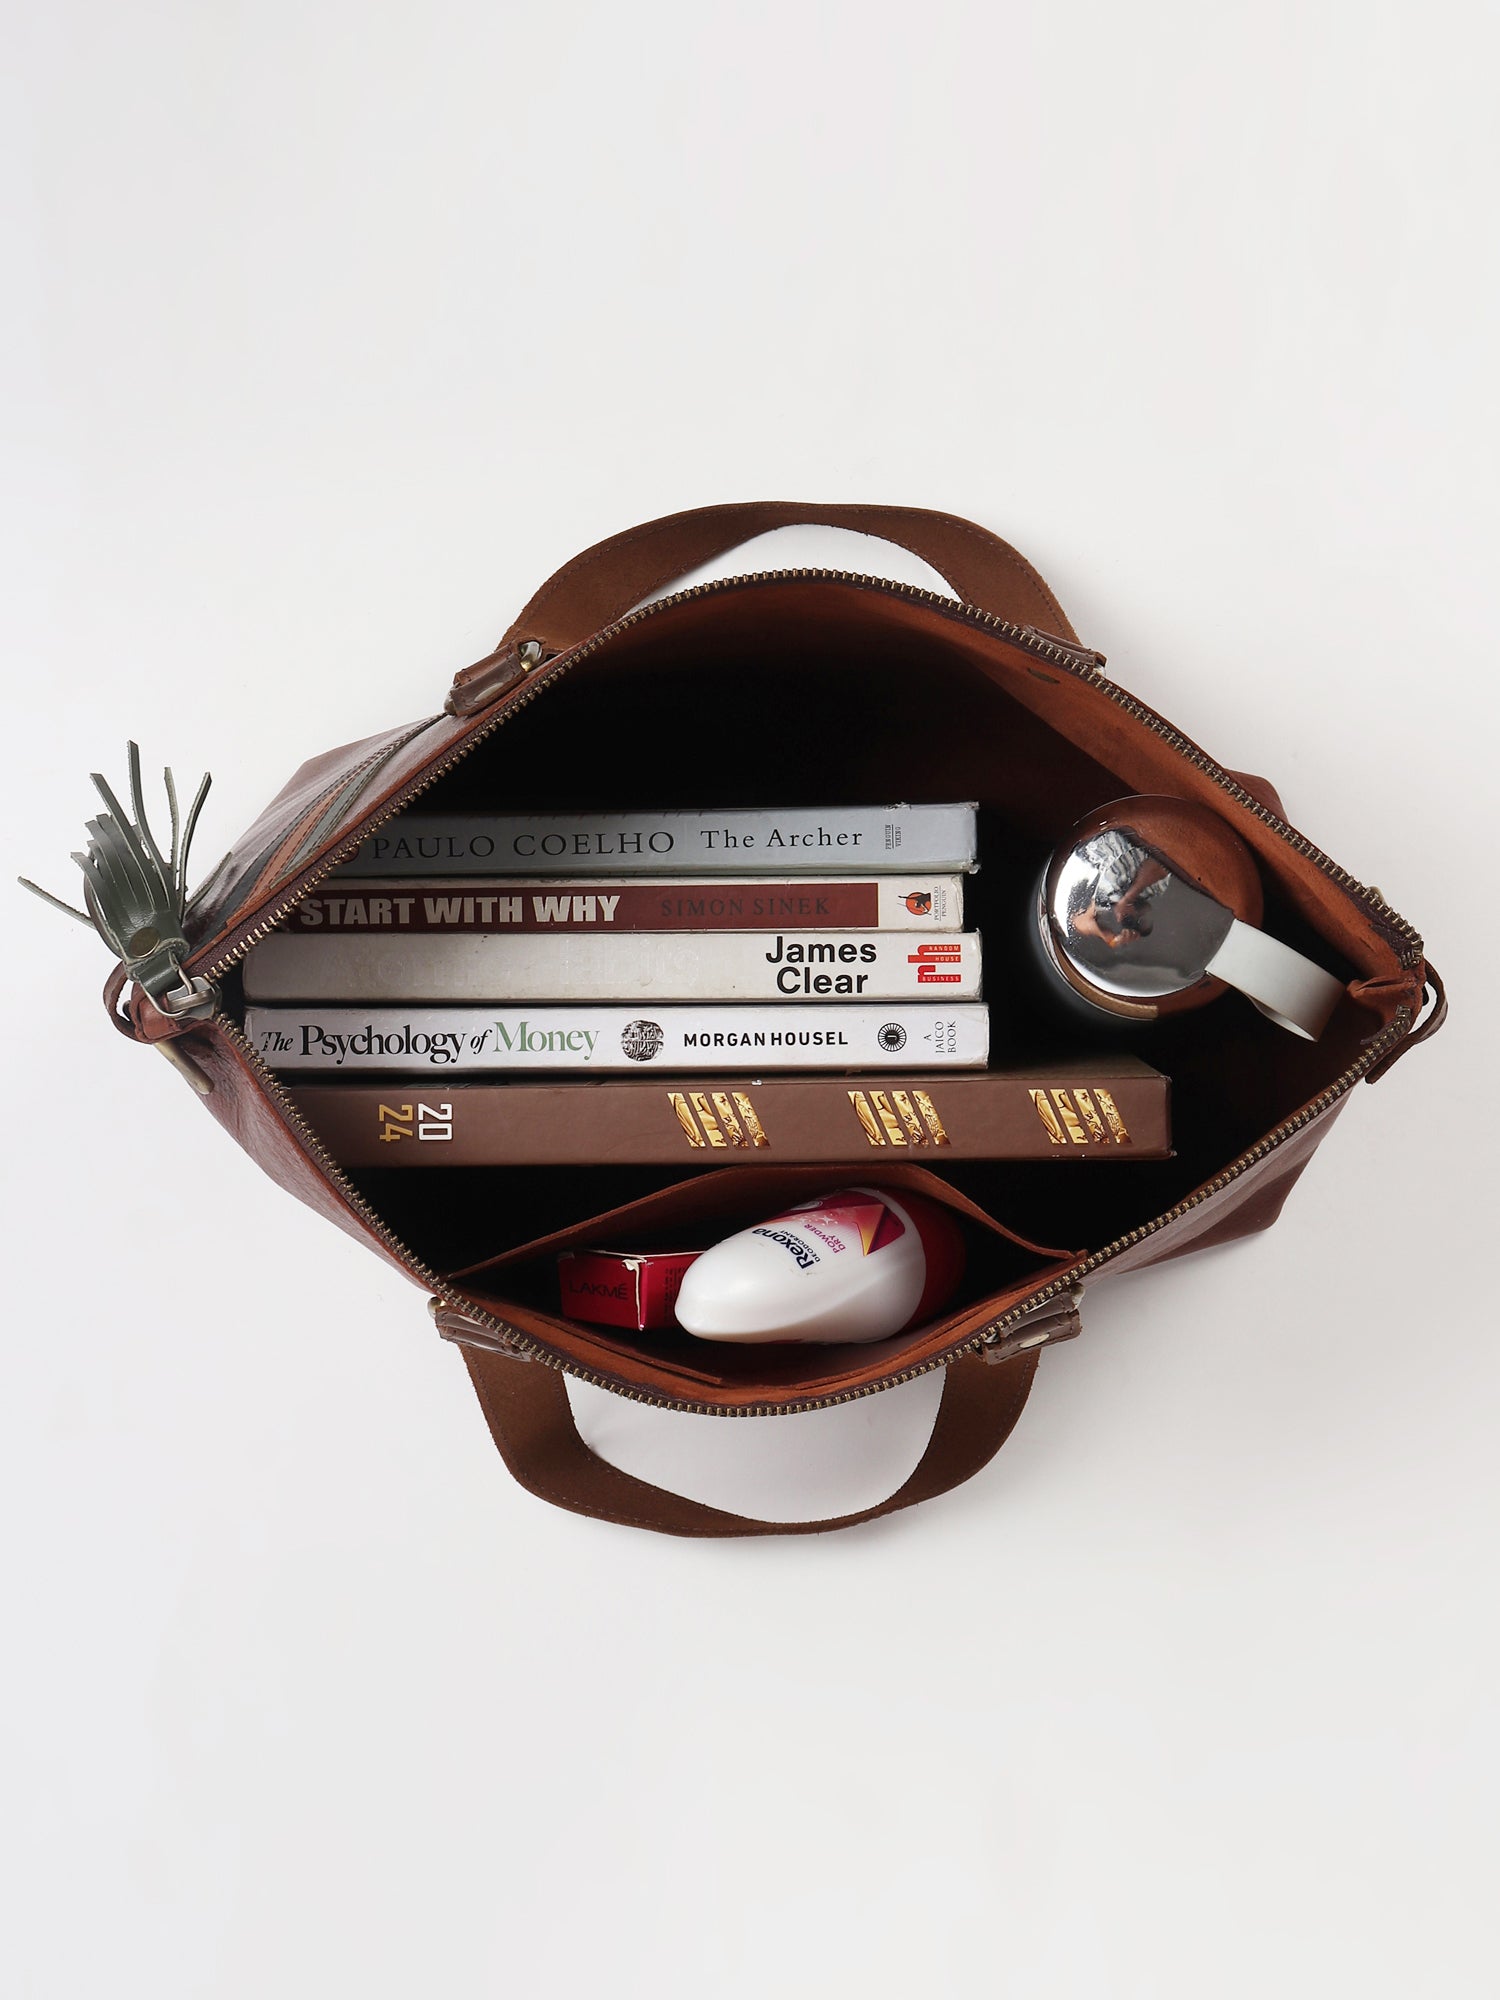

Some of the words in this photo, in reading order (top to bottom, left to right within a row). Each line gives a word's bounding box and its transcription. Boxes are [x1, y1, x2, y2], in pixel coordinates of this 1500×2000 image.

[373, 835, 494, 860] PAULO
[513, 831, 674, 856] COELHO
[700, 829, 755, 850] The
[766, 826, 863, 848] Archer
[300, 897, 415, 926] START
[424, 896, 524, 924] WITH
[531, 895, 621, 923] WHY
[661, 898, 744, 918] SIMON
[753, 897, 830, 916] SINEK
[765, 935, 878, 964] James
[776, 966, 869, 995] Clear
[260, 1031, 296, 1052] The
[299, 1024, 466, 1065] Psychology
[470, 1028, 493, 1055] of
[492, 1021, 600, 1061] Money
[934, 1021, 945, 1053] JAICO
[946, 1020, 957, 1053] BOOK
[378, 1103, 414, 1142] 24
[418, 1103, 453, 1142] 20
[752, 1228, 815, 1270] Rexona
[780, 1230, 821, 1263] DEODORANT
[803, 1223, 840, 1254] POWDER
[828, 1234, 847, 1251] DRY
[568, 1280, 629, 1301] LAKMÉ
